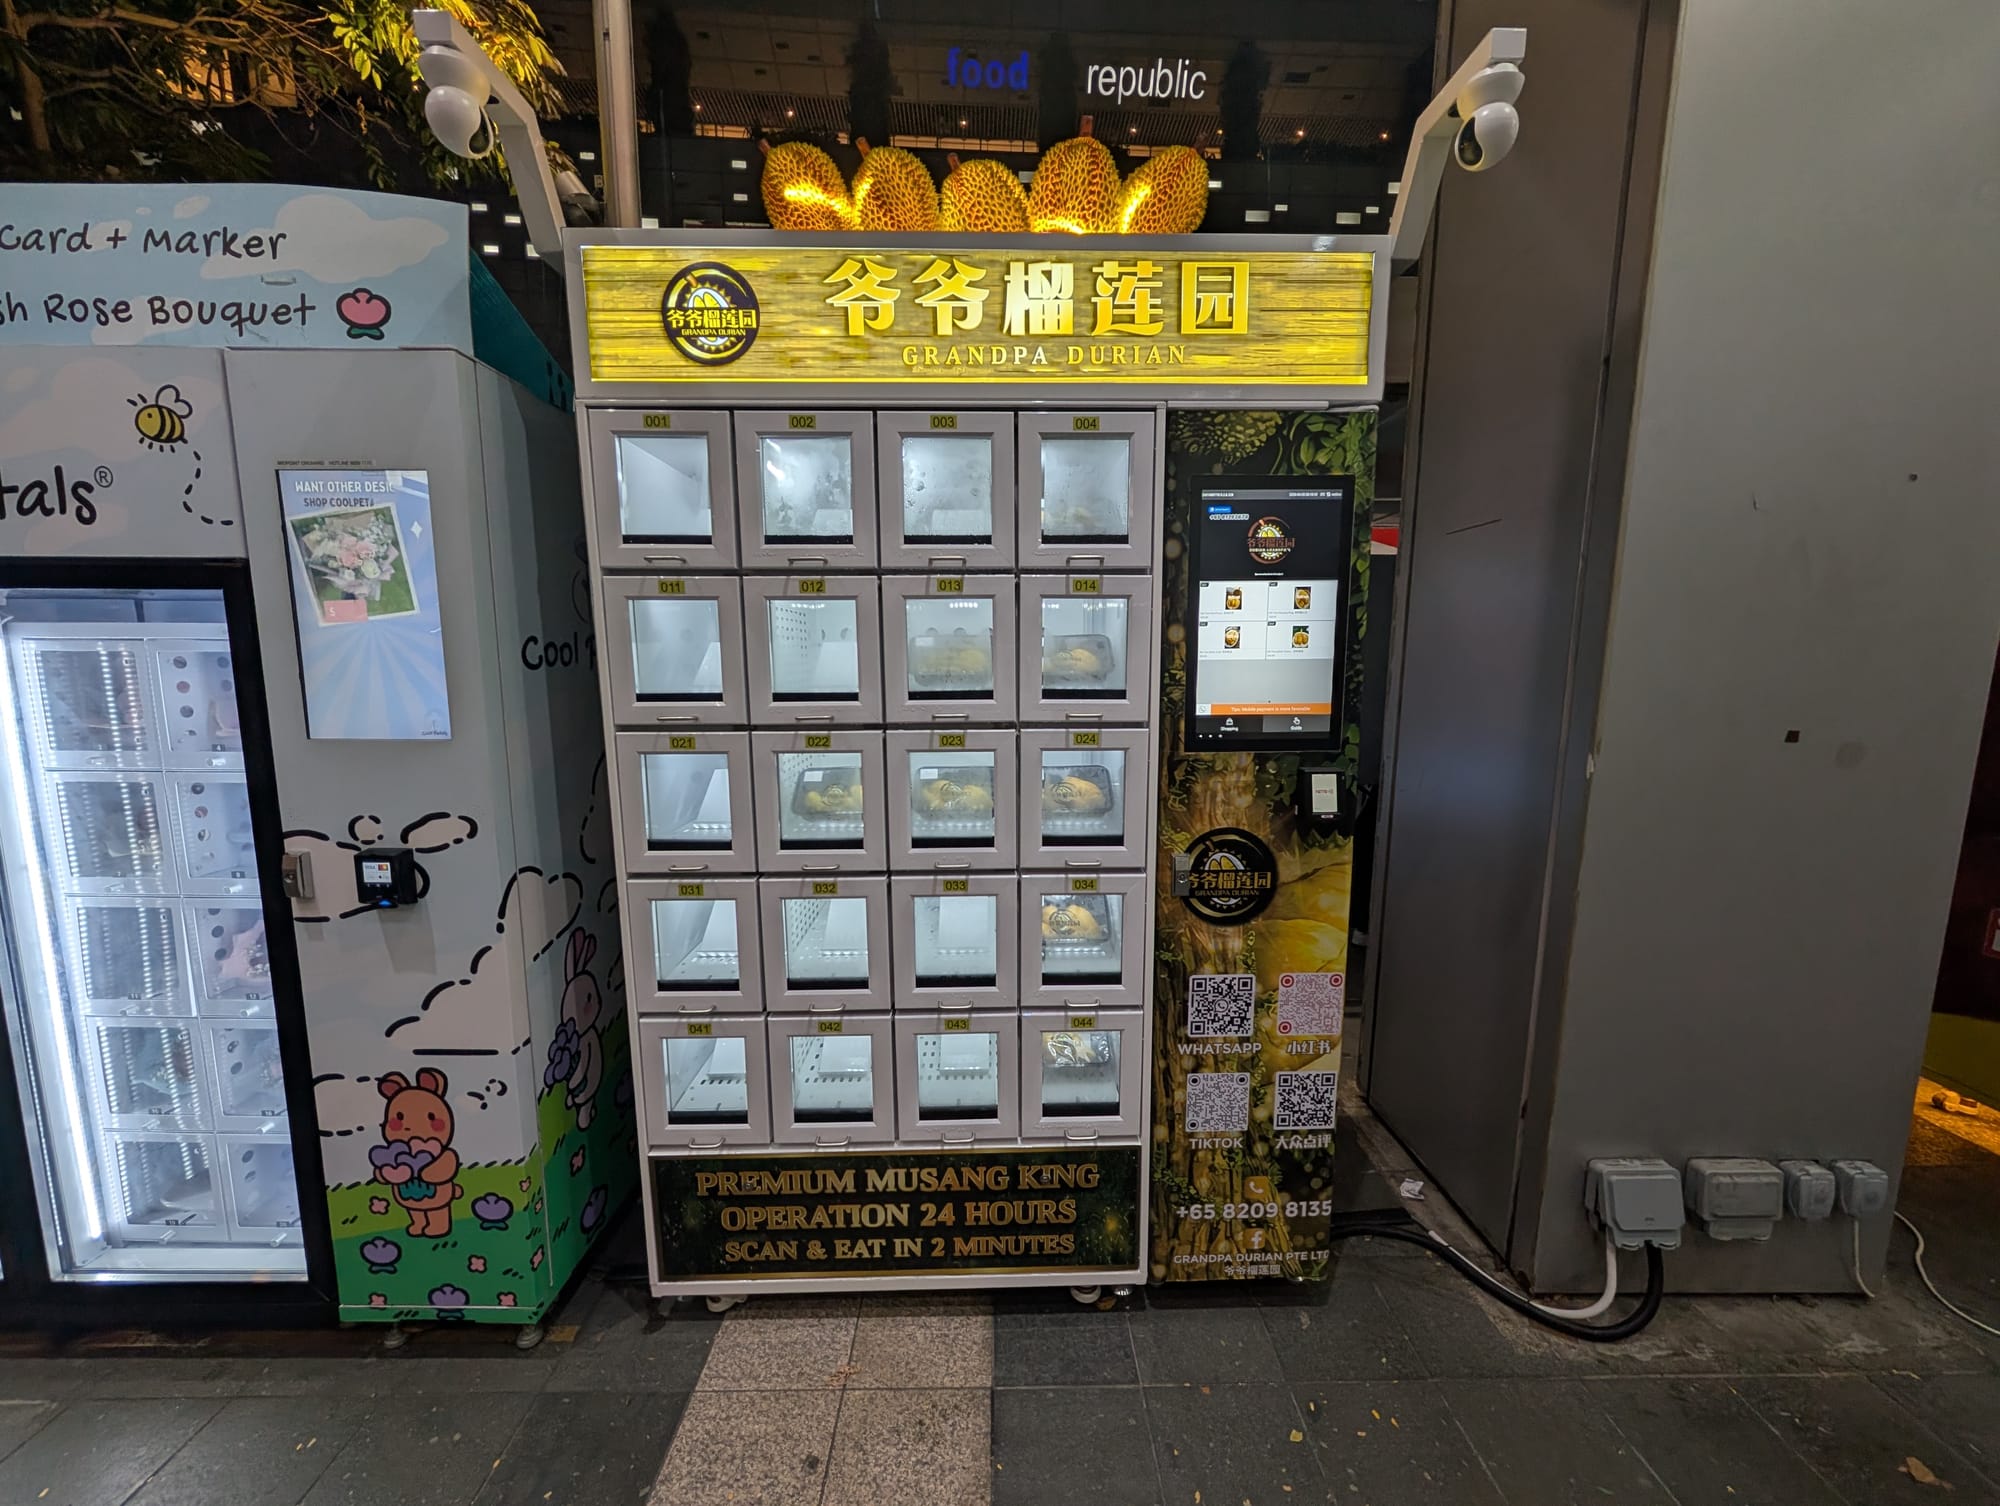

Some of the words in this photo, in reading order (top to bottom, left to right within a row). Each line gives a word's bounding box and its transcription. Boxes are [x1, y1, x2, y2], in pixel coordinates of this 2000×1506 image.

[947, 47, 1030, 91] food
[1087, 57, 1207, 105] republic
[106, 227, 128, 249] +
[143, 226, 288, 260] Marker
[822, 258, 1250, 336] 爷爷榴莲园
[44, 293, 133, 326] Rose
[147, 292, 317, 337] Bouquet
[666, 309, 757, 329] 爷爷榴莲园
[681, 328, 717, 336] GRANDPA
[718, 328, 747, 336] DURIAN
[902, 345, 1048, 366] GRANDPA
[1067, 345, 1186, 365] DURIAN
[645, 415, 667, 428] 001
[791, 416, 813, 428] 002
[933, 416, 955, 428] 003
[1075, 417, 1097, 429] 004
[295, 481, 324, 492] WANT
[327, 481, 361, 492] OTHER
[303, 498, 328, 507] SHOP
[660, 581, 681, 593] 011
[801, 581, 823, 593] 012
[939, 580, 961, 591] 013
[1075, 580, 1096, 591] 014
[521, 631, 579, 671] Cool
[671, 737, 693, 749] 021
[807, 736, 830, 748] 022
[941, 735, 962, 746] 023
[1075, 734, 1096, 745] 024
[681, 884, 701, 895] 031
[815, 882, 836, 894] 032
[945, 880, 966, 891] 033
[1074, 879, 1094, 890] 034
[1195, 889, 1231, 897] GRANDPA
[689, 1024, 710, 1034] 041
[820, 1022, 840, 1032] 042
[947, 1019, 967, 1030] 043
[1073, 1018, 1092, 1028] 044
[1177, 1042, 1262, 1055] WHATSAPP
[1287, 1040, 1331, 1055] 小红书
[1189, 1137, 1243, 1149] TIKTOK
[1275, 1134, 1332, 1149] 大众点评
[695, 1169, 856, 1197] PREMIUM
[866, 1165, 1010, 1193] MUSANG
[1017, 1163, 1100, 1190] KING
[721, 1203, 910, 1232] OPERATION
[920, 1202, 955, 1227] 24
[964, 1199, 1077, 1226] HOURS
[1176, 1203, 1216, 1220] +65
[1222, 1202, 1279, 1219] 8209
[1285, 1200, 1332, 1217] 8135
[725, 1240, 798, 1262] SCAN
[806, 1239, 827, 1260] &
[834, 1238, 886, 1259] EAT
[894, 1237, 924, 1258] IN
[930, 1236, 945, 1257] 2
[953, 1233, 1075, 1257] MINUTES
[1173, 1253, 1233, 1264] GRANDPA
[1236, 1252, 1283, 1263] DURIAN
[1285, 1251, 1308, 1261] PTE
